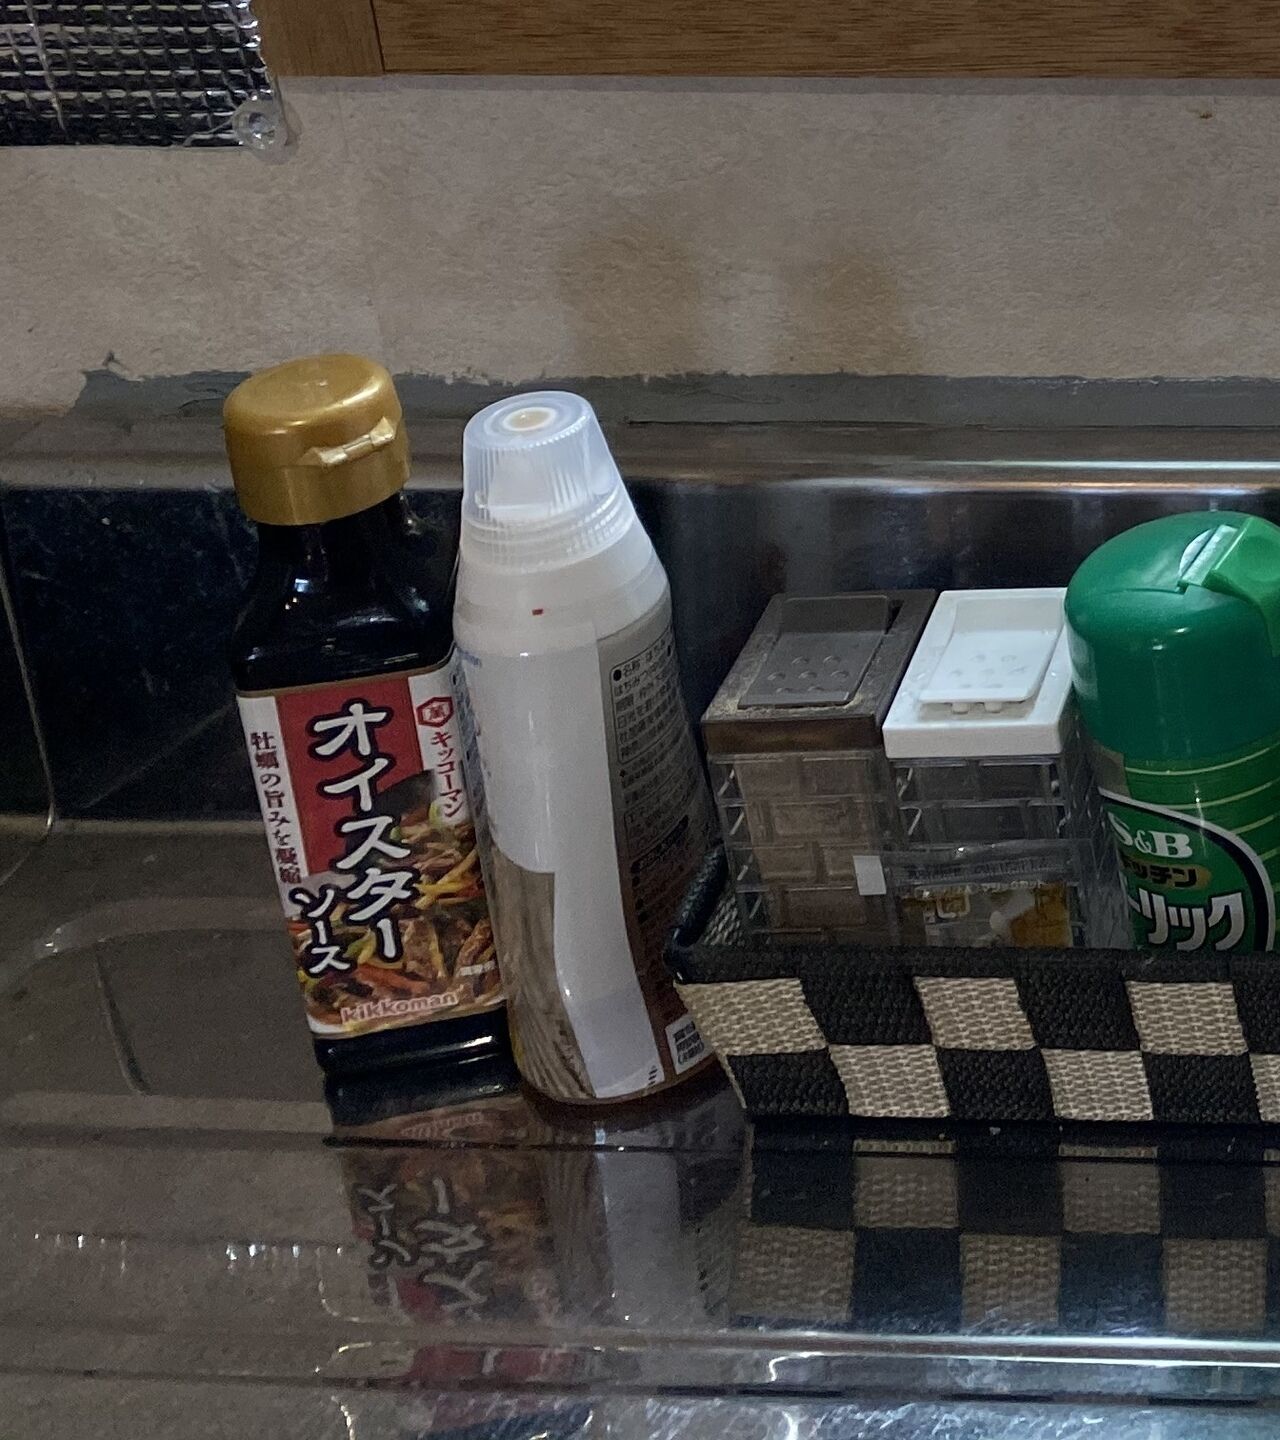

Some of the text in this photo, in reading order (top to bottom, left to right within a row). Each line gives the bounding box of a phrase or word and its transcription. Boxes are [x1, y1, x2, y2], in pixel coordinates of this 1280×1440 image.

[431, 731, 464, 818] キッコーマン
[313, 702, 412, 959] オイスター
[1107, 811, 1194, 859] S&B
[294, 889, 351, 974] ソース
[340, 990, 458, 1025] kikkoman
